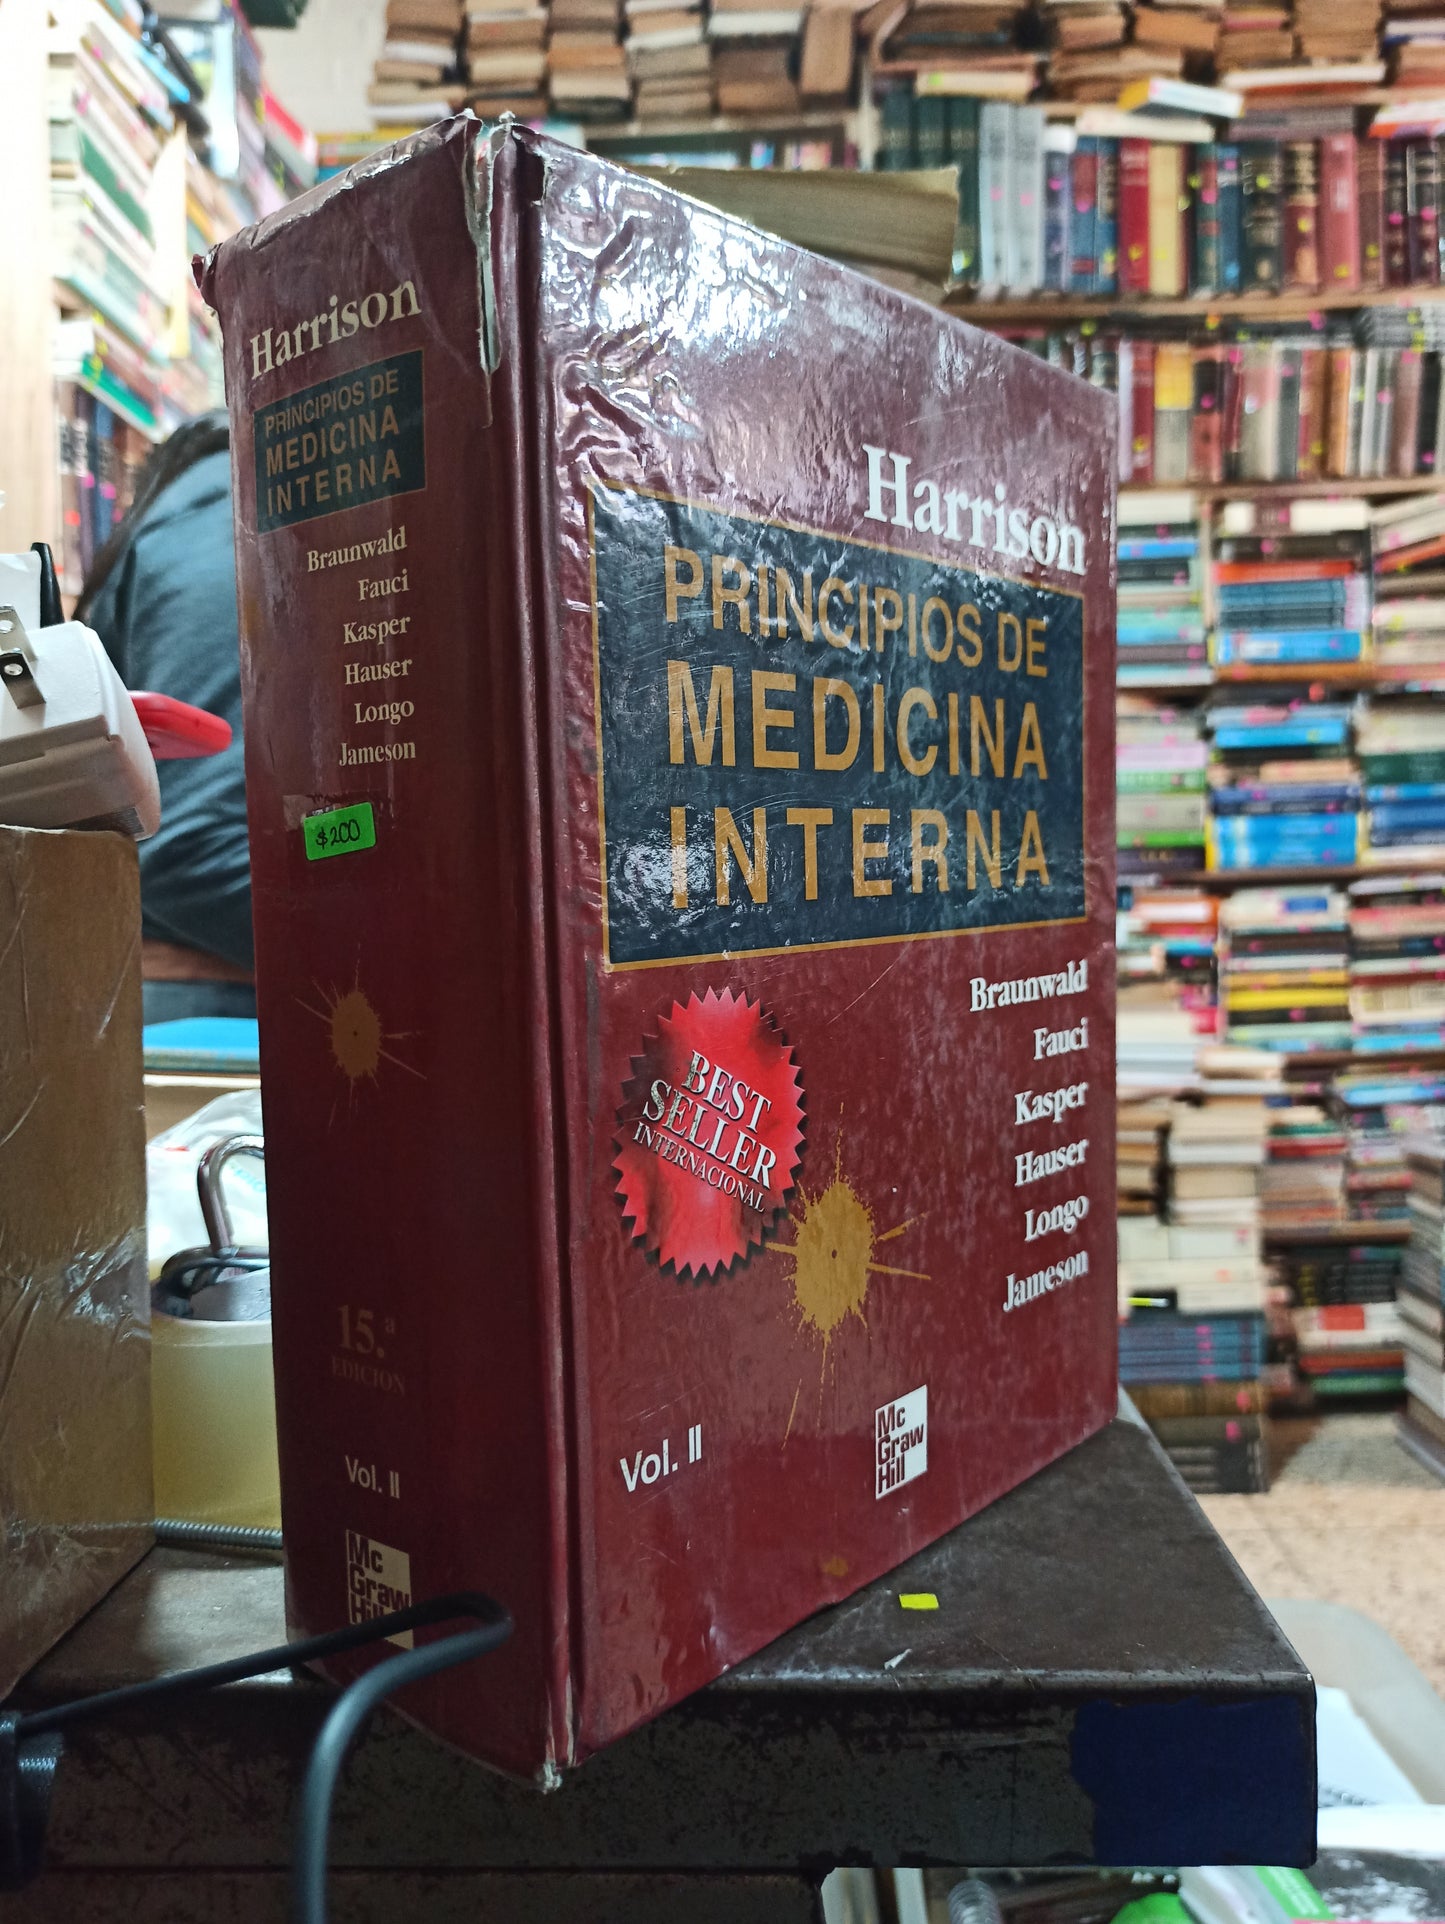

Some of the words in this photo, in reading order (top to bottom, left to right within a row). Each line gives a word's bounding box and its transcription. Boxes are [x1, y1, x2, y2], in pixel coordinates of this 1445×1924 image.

[250, 280, 421, 380] Harrison
[264, 381, 365, 438] PRINCIPIOS
[371, 369, 399, 399] DE
[266, 405, 399, 477] MEDICINA
[267, 449, 401, 517] INTERNA
[862, 443, 1086, 576] Harrison
[307, 525, 407, 572] Braunwald
[358, 568, 409, 600] Fauci
[343, 616, 411, 645] Kasper
[664, 545, 983, 669] PRINCIPIOS
[997, 612, 1048, 678] DE
[344, 659, 412, 685] Hauser
[354, 700, 415, 725] Longo
[667, 659, 1048, 780] MEDICINA
[339, 741, 416, 766] Jameson
[315, 818, 360, 850] $200
[668, 806, 1050, 909] INTERNA
[969, 958, 1088, 1013] Braunwald
[1033, 1017, 1089, 1061] Fauci
[681, 1049, 772, 1133] BEST
[1014, 1081, 1089, 1125] Kasper
[642, 1079, 777, 1189] SELLER
[632, 1121, 765, 1213] INTERNACIONAL
[1014, 1139, 1089, 1187] Hauser
[1024, 1195, 1089, 1242] Longo
[1002, 1250, 1089, 1313] Jameson
[877, 1402, 906, 1438] Mc
[620, 1438, 679, 1492] Vol.
[688, 1424, 702, 1464] II
[877, 1424, 924, 1466] Graw
[345, 1455, 384, 1494] Vol.
[389, 1470, 400, 1499] II
[877, 1456, 906, 1495] Hill
[349, 1531, 384, 1573] Mc
[350, 1563, 410, 1612] Graw
